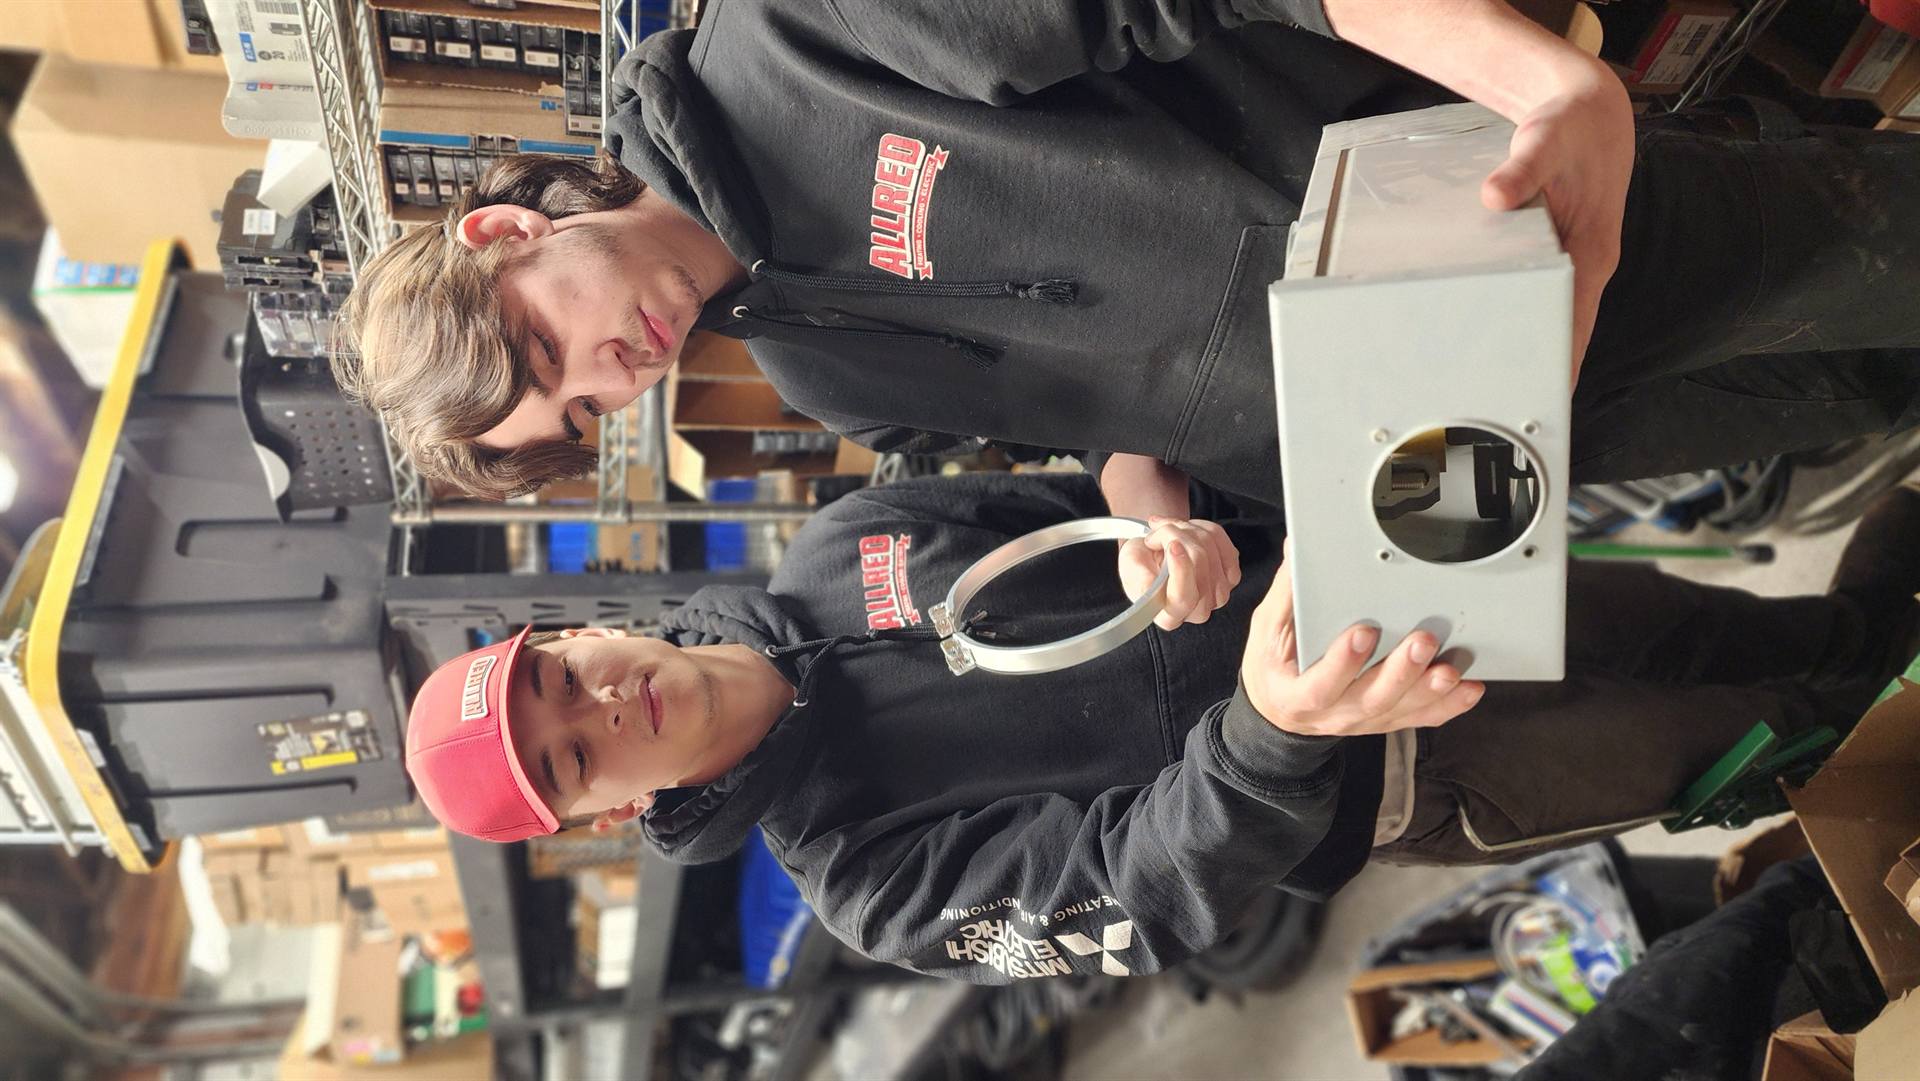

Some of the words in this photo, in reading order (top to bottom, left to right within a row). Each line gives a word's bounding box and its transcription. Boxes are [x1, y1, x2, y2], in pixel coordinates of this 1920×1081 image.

[869, 133, 926, 280] ALLRED
[916, 203, 926, 234] COOLING
[921, 160, 935, 196] ELECTRIC
[859, 534, 906, 630] ALLRED
[940, 897, 1020, 921] NDITIONING
[1039, 914, 1050, 928] &
[945, 940, 1072, 978] MITSUBISHI
